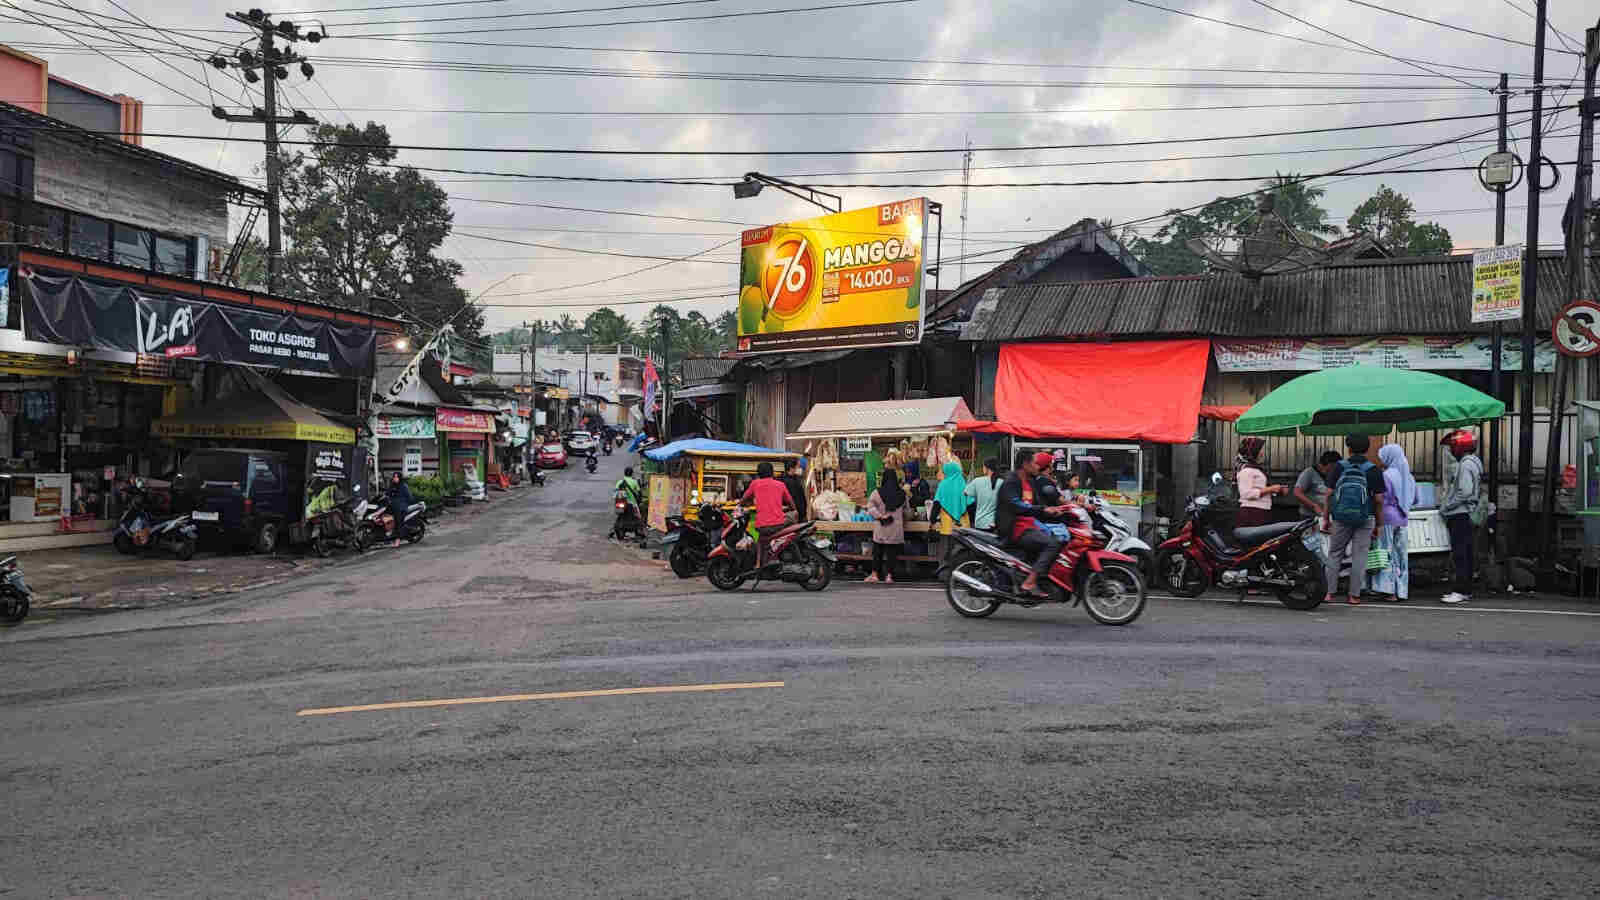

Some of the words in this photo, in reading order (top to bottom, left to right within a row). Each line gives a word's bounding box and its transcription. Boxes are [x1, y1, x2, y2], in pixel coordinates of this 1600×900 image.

[823, 239, 915, 269] MANGGA
[767, 238, 808, 309] 76
[249, 328, 277, 343] TOKO
[277, 332, 316, 349] ASGROS
